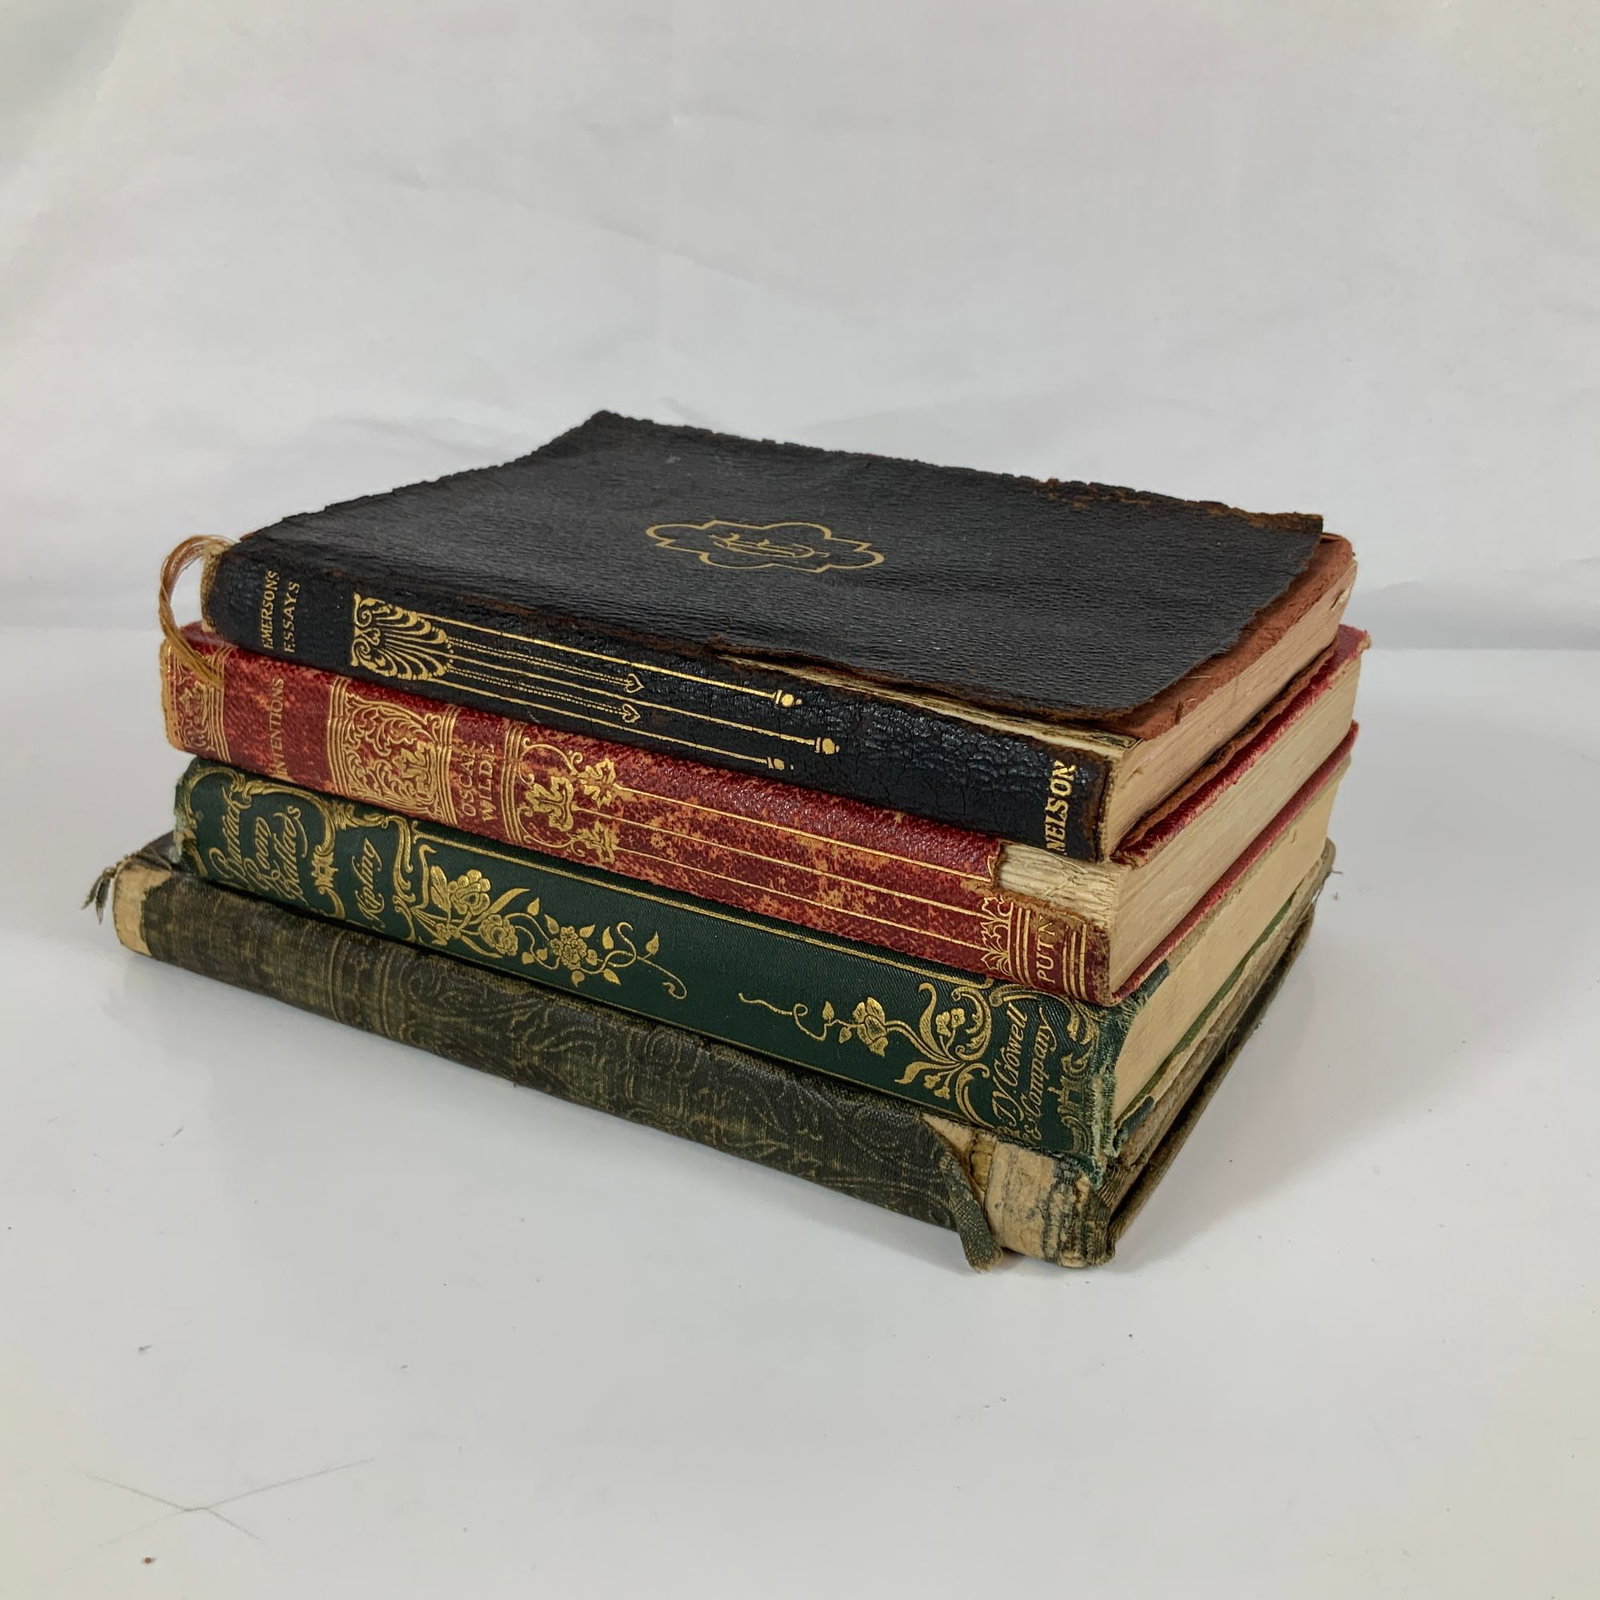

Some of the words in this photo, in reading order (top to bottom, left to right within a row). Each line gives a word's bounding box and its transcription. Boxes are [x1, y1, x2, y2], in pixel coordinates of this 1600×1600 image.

[283, 581, 300, 653] ESSAYS
[269, 677, 287, 777] INTENTIONS
[459, 741, 477, 817] OSCAR
[1045, 759, 1077, 856] NELSON
[243, 816, 273, 891] Room
[271, 805, 309, 906] Ballads
[351, 838, 386, 928] Kipling
[994, 1002, 1028, 1087] Crowell
[1020, 1005, 1057, 1118] Company
